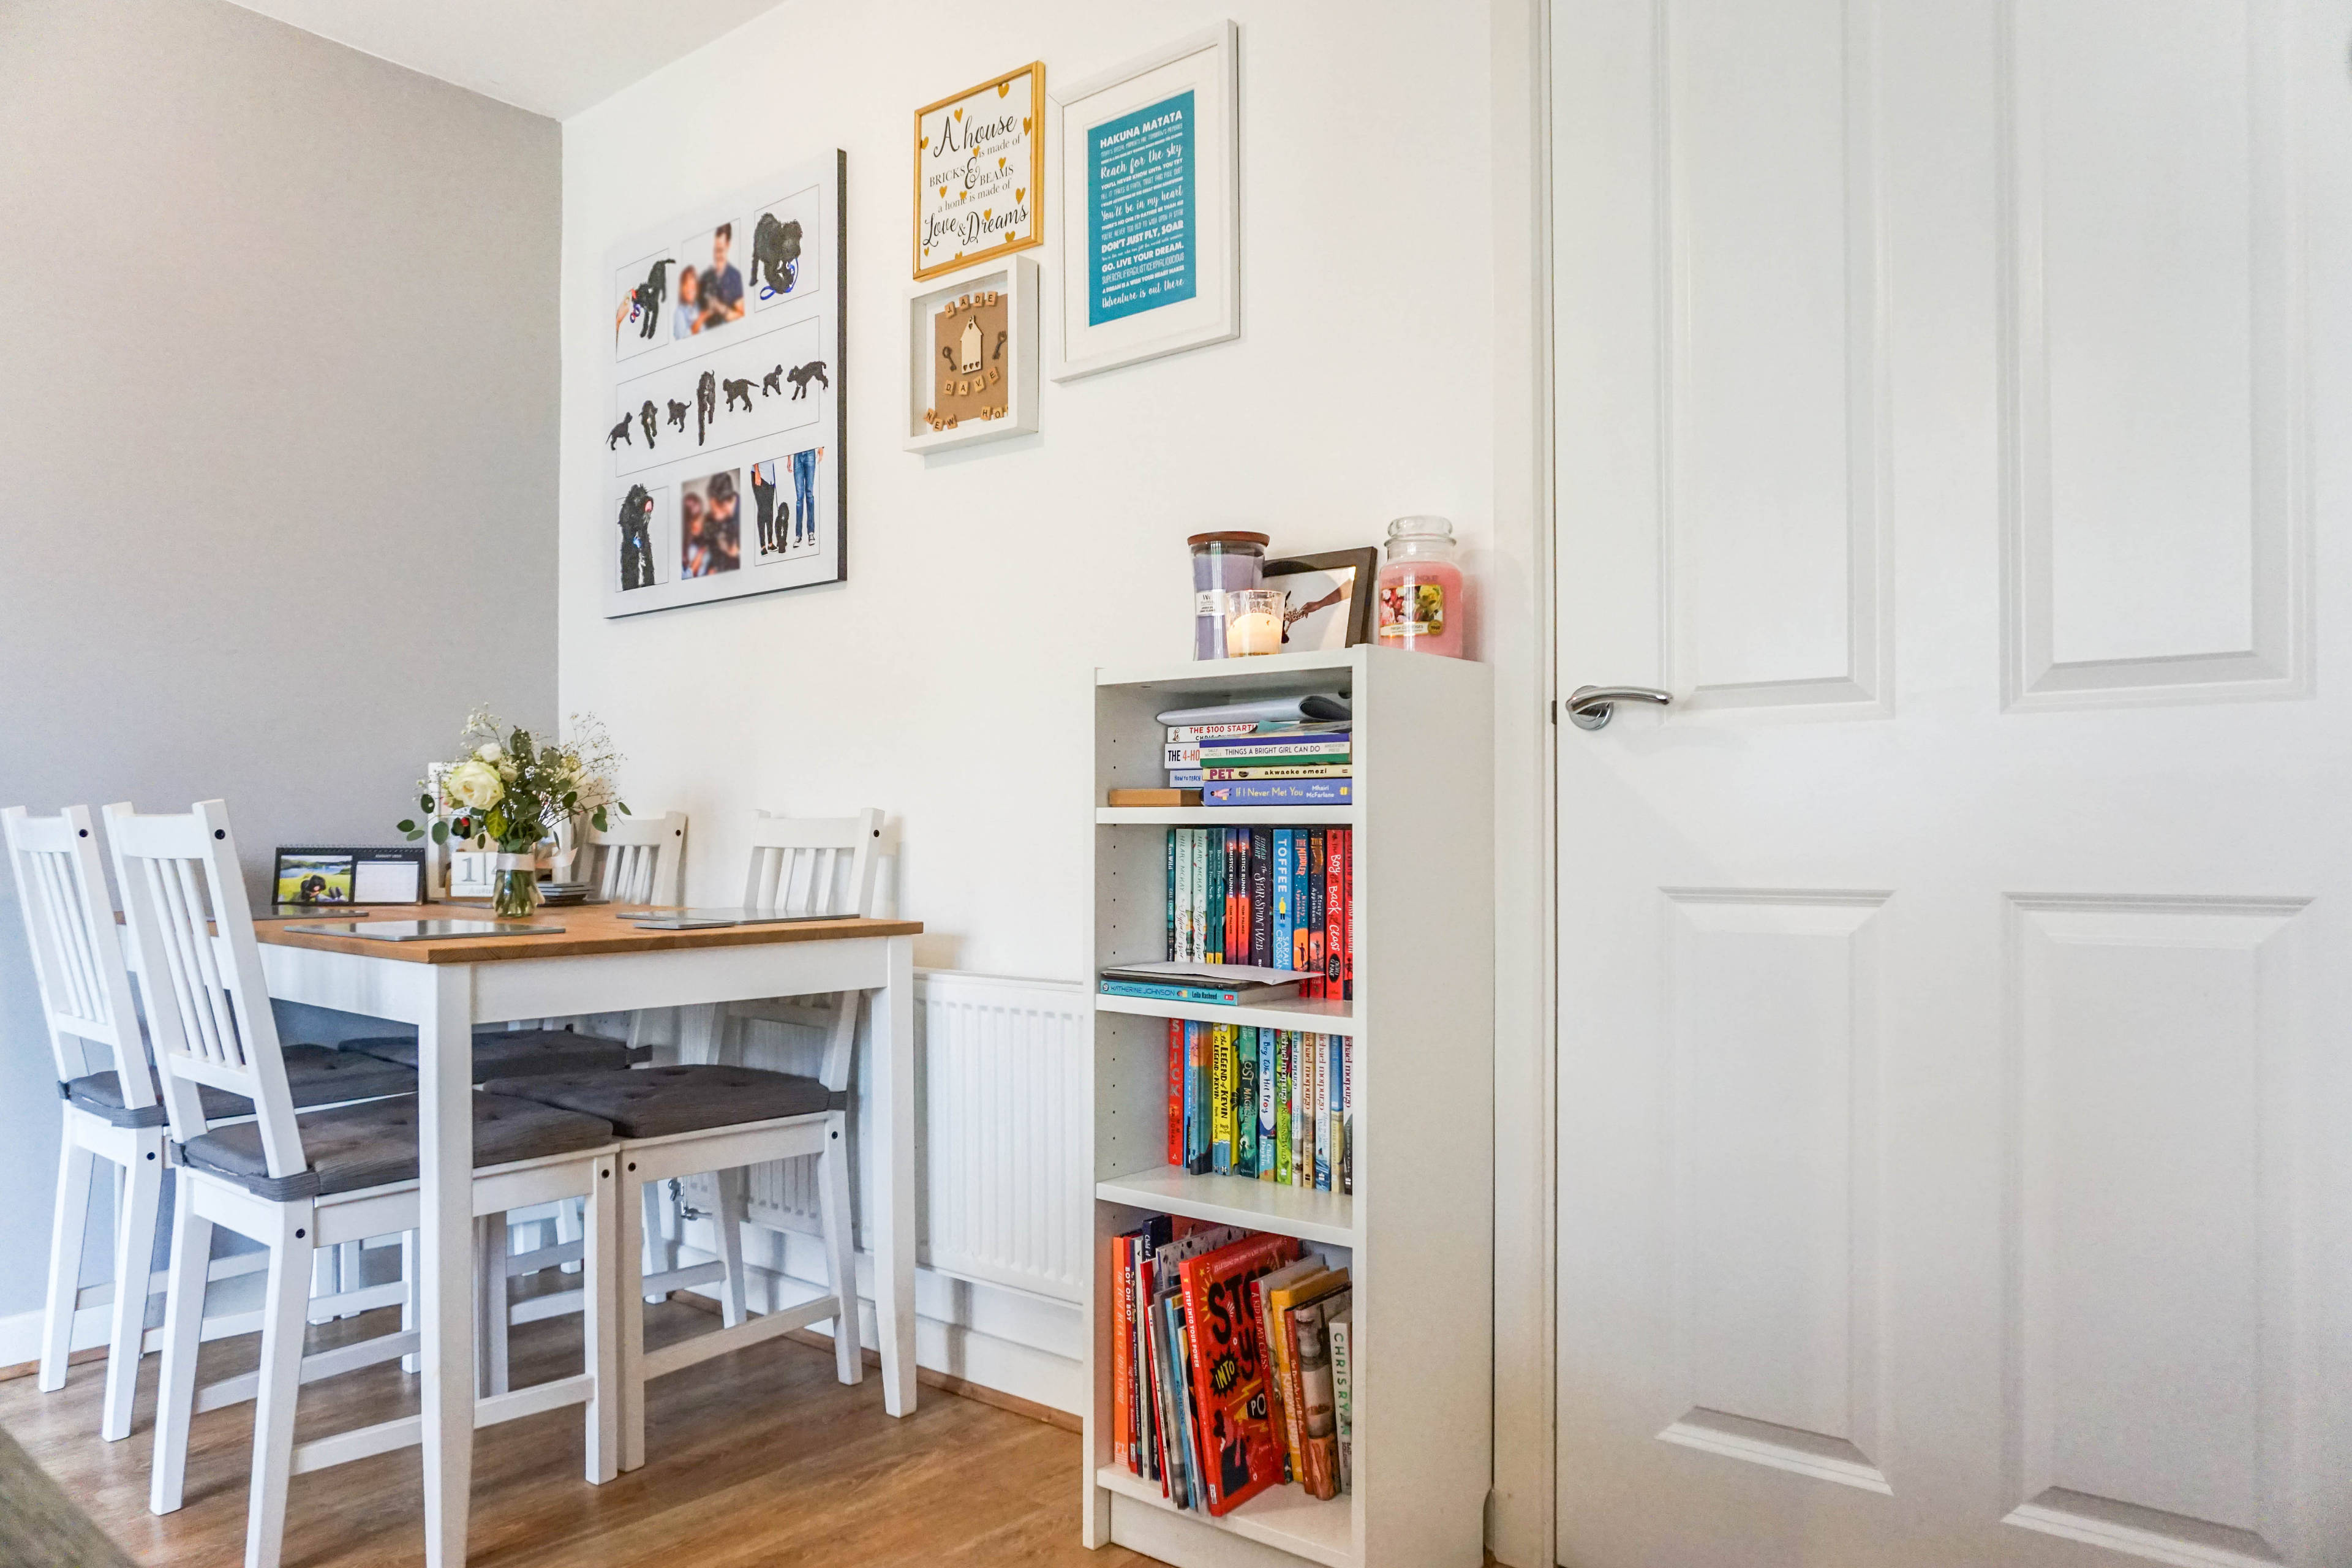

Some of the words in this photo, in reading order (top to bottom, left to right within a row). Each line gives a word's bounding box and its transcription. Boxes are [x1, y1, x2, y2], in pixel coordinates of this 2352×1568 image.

[933, 116, 960, 157] A
[963, 115, 1017, 149] house
[1100, 126, 1139, 148] HAKUNA
[1142, 110, 1182, 133] MATATA
[987, 141, 1009, 156] made
[1012, 133, 1022, 146] of
[1101, 160, 1126, 179] Reach
[1130, 157, 1144, 173] for
[1149, 149, 1163, 162] the
[1166, 143, 1182, 157] sky
[930, 167, 965, 187] BRICKS
[980, 165, 1014, 186] BEAMS
[1132, 170, 1147, 179] KNOW
[945, 197, 967, 210] home
[970, 192, 975, 203] is
[978, 185, 999, 200] made
[1001, 179, 1011, 191] of
[1101, 206, 1121, 221] You'll
[1125, 202, 1133, 213] be
[1137, 200, 1144, 209] in
[1147, 197, 1158, 206] my
[1161, 185, 1183, 200] heart
[923, 213, 958, 247] Love
[957, 223, 965, 237] &
[963, 205, 1028, 245] Dreams
[1101, 238, 1125, 253] DON'T
[1126, 232, 1143, 246] JUST
[1144, 228, 1159, 239] FLY,
[1161, 220, 1183, 235] SOAR
[1102, 263, 1115, 272] GO.
[1117, 257, 1131, 268] LIVE
[1133, 251, 1153, 262] YOUR
[1155, 241, 1183, 256] DREAM.
[1102, 292, 1137, 307] Adventure
[1148, 282, 1160, 294] out
[1164, 279, 1183, 290] there
[1168, 749, 1180, 761] THE
[1210, 769, 1234, 779] PET
[1235, 788, 1241, 797] If
[1246, 788, 1270, 797] Never
[1272, 787, 1287, 796] Met
[1290, 787, 1303, 796] You
[1278, 839, 1287, 892] TOFFEE
[1295, 848, 1307, 875] MIDDLER
[1256, 929, 1264, 950] WEB
[1126, 1288, 1131, 1300] OH
[1183, 1291, 1191, 1307] STEP
[1186, 1308, 1194, 1324] INTO
[1252, 1299, 1261, 1314] KID
[1254, 1316, 1262, 1324] IN
[1188, 1325, 1197, 1343] YOUR
[1255, 1325, 1265, 1340] MY
[1191, 1344, 1200, 1368] POWER
[1257, 1342, 1269, 1370] CLASS
[1333, 1332, 1347, 1385] CHRIS
[1215, 1360, 1235, 1390] INTO
